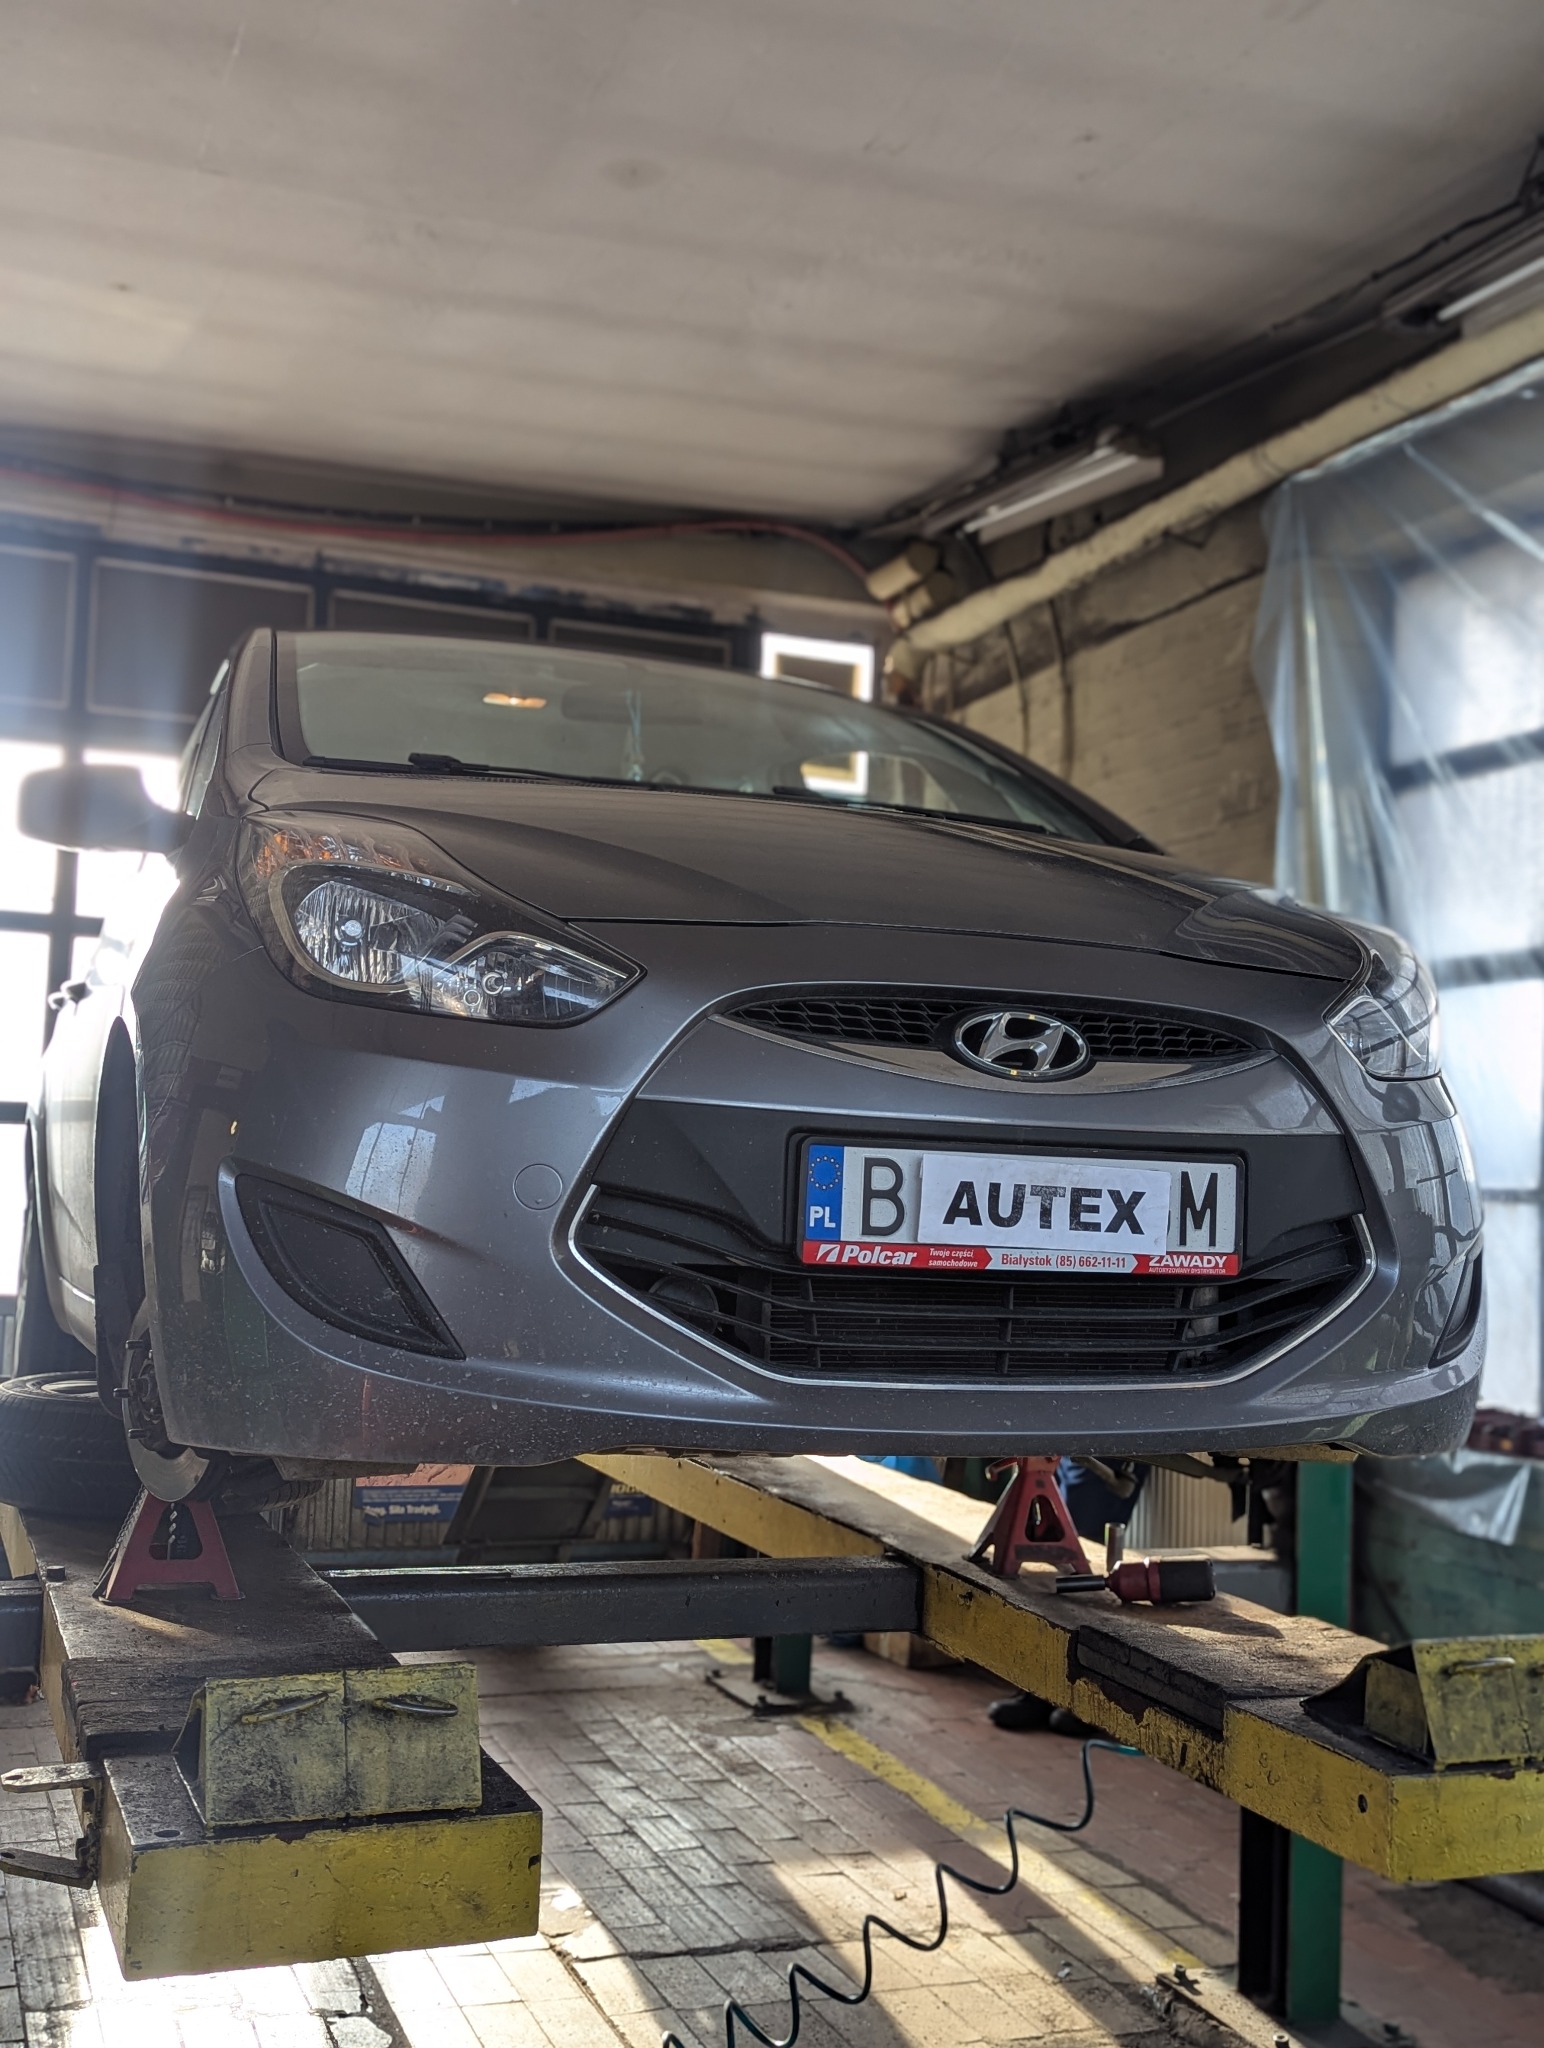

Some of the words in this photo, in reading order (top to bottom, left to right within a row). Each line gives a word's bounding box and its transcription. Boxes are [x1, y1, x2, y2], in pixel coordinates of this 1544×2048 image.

[861, 1157, 905, 1236] B
[809, 1206, 836, 1228] PL
[942, 1180, 1146, 1236] AUTEX
[1179, 1171, 1218, 1247] M
[841, 1244, 917, 1266] Polcar
[928, 1259, 978, 1268] samochodowe
[929, 1248, 950, 1258] Twoje
[952, 1249, 974, 1259] części
[1001, 1253, 1052, 1268] Białystok
[1055, 1254, 1076, 1270] (85)
[1078, 1255, 1126, 1269] 662-11-11
[1148, 1254, 1228, 1267] ZAWADY
